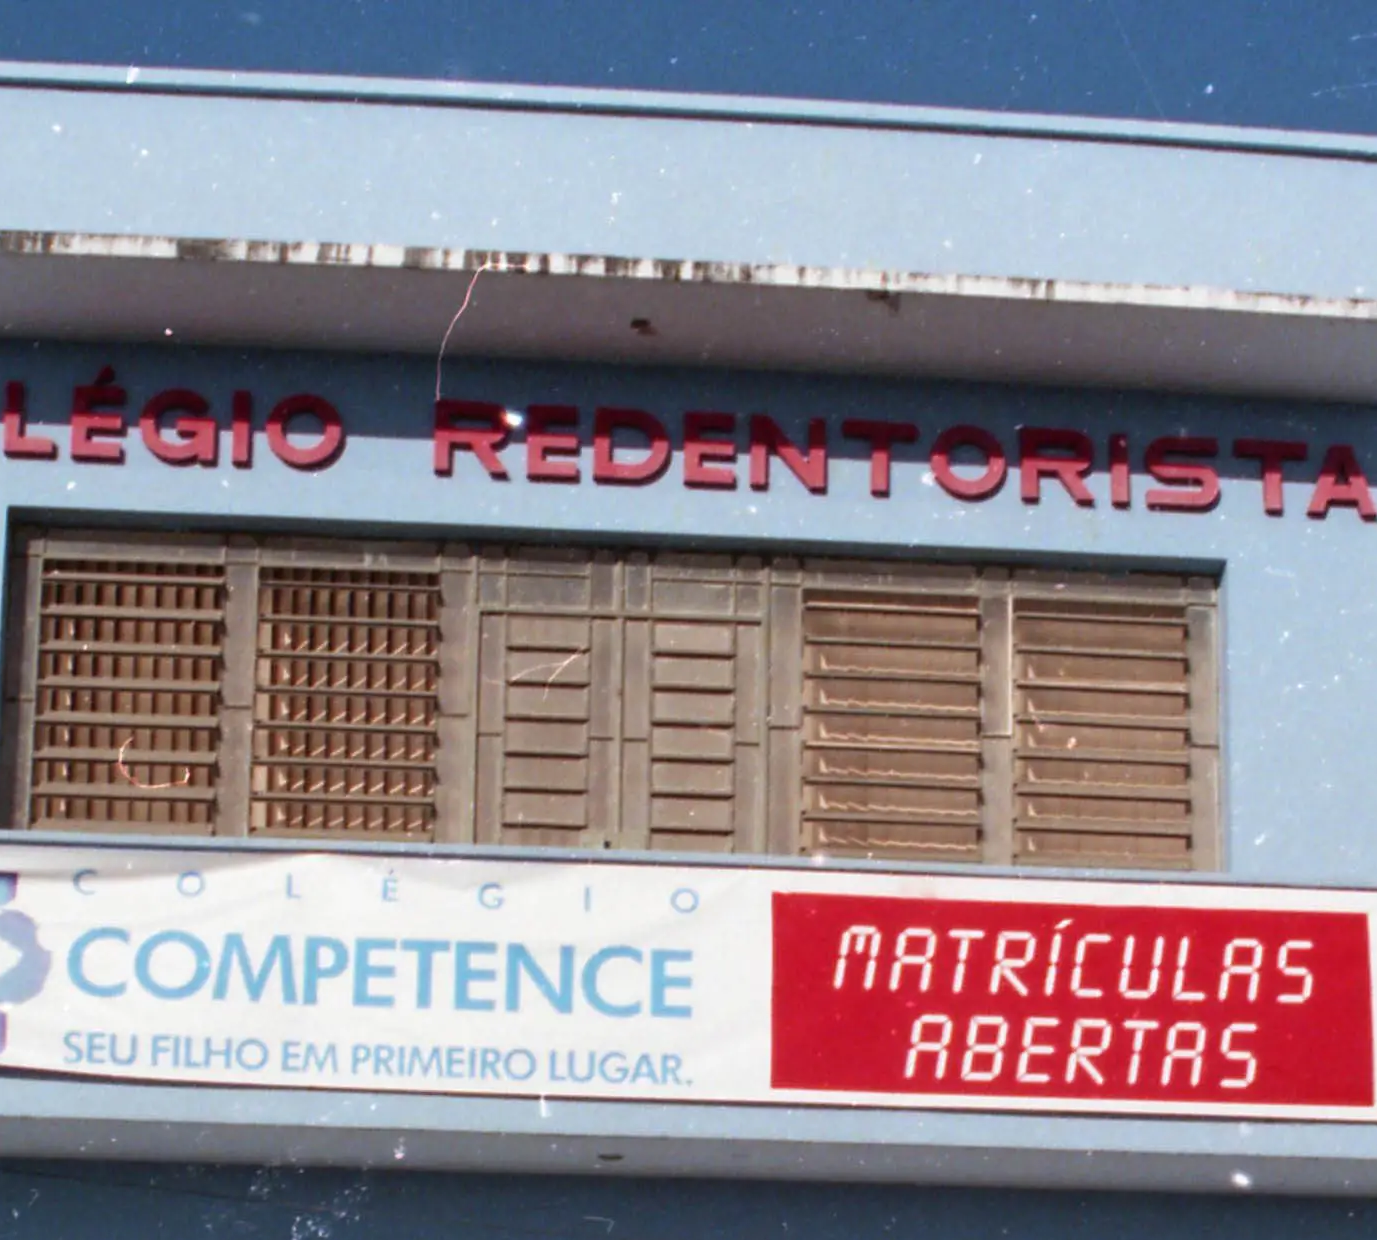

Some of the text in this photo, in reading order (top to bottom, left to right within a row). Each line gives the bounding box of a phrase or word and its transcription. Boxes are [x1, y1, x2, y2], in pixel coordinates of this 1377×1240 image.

[434, 399, 1377, 523] REDENTORISTA
[72, 867, 700, 915] COLÉGIO
[66, 926, 695, 1019] COMPETENCE
[832, 918, 1314, 1004] MATRÍCULAS
[62, 1030, 694, 1087] SEU FILHO EM PRIMEIRO LUGAR.
[903, 1013, 1259, 1089] ABERTAS
